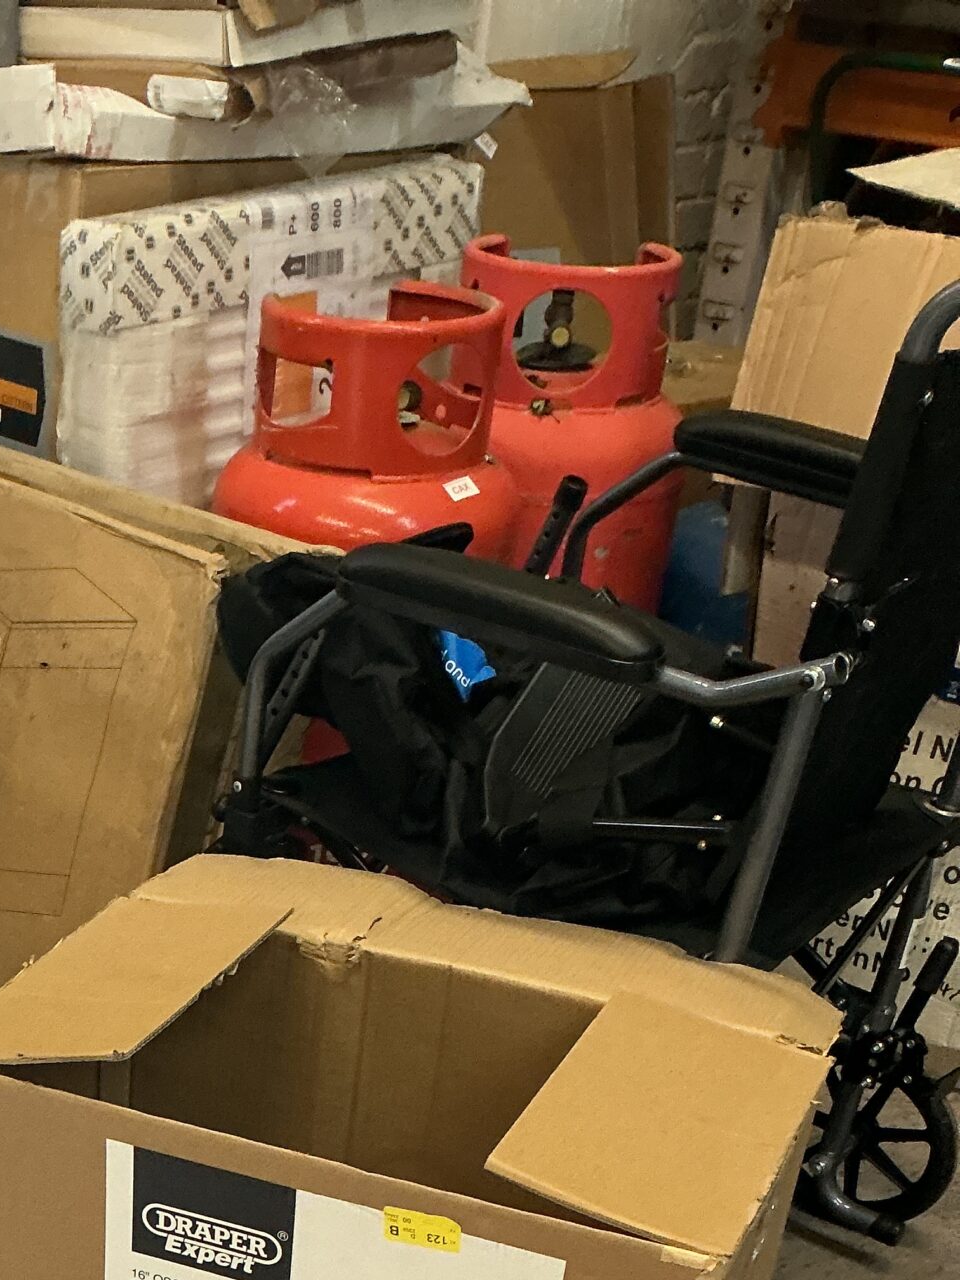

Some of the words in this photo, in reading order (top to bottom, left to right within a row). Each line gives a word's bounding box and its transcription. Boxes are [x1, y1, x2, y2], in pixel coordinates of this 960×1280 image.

[310, 202, 320, 232] 600
[333, 198, 342, 229] 800
[175, 233, 205, 273] Stelrad
[200, 233, 227, 270] Stelrad
[134, 259, 164, 298] Stelrad
[165, 259, 192, 297] Stelrad
[120, 283, 151, 322] Stelrad
[445, 660, 470, 687] and
[155, 1209, 268, 1259] DRAPER
[390, 1225, 399, 1236] B
[427, 1234, 448, 1245] 123
[165, 1234, 255, 1274] Expert
[131, 1268, 150, 1280] 16"
